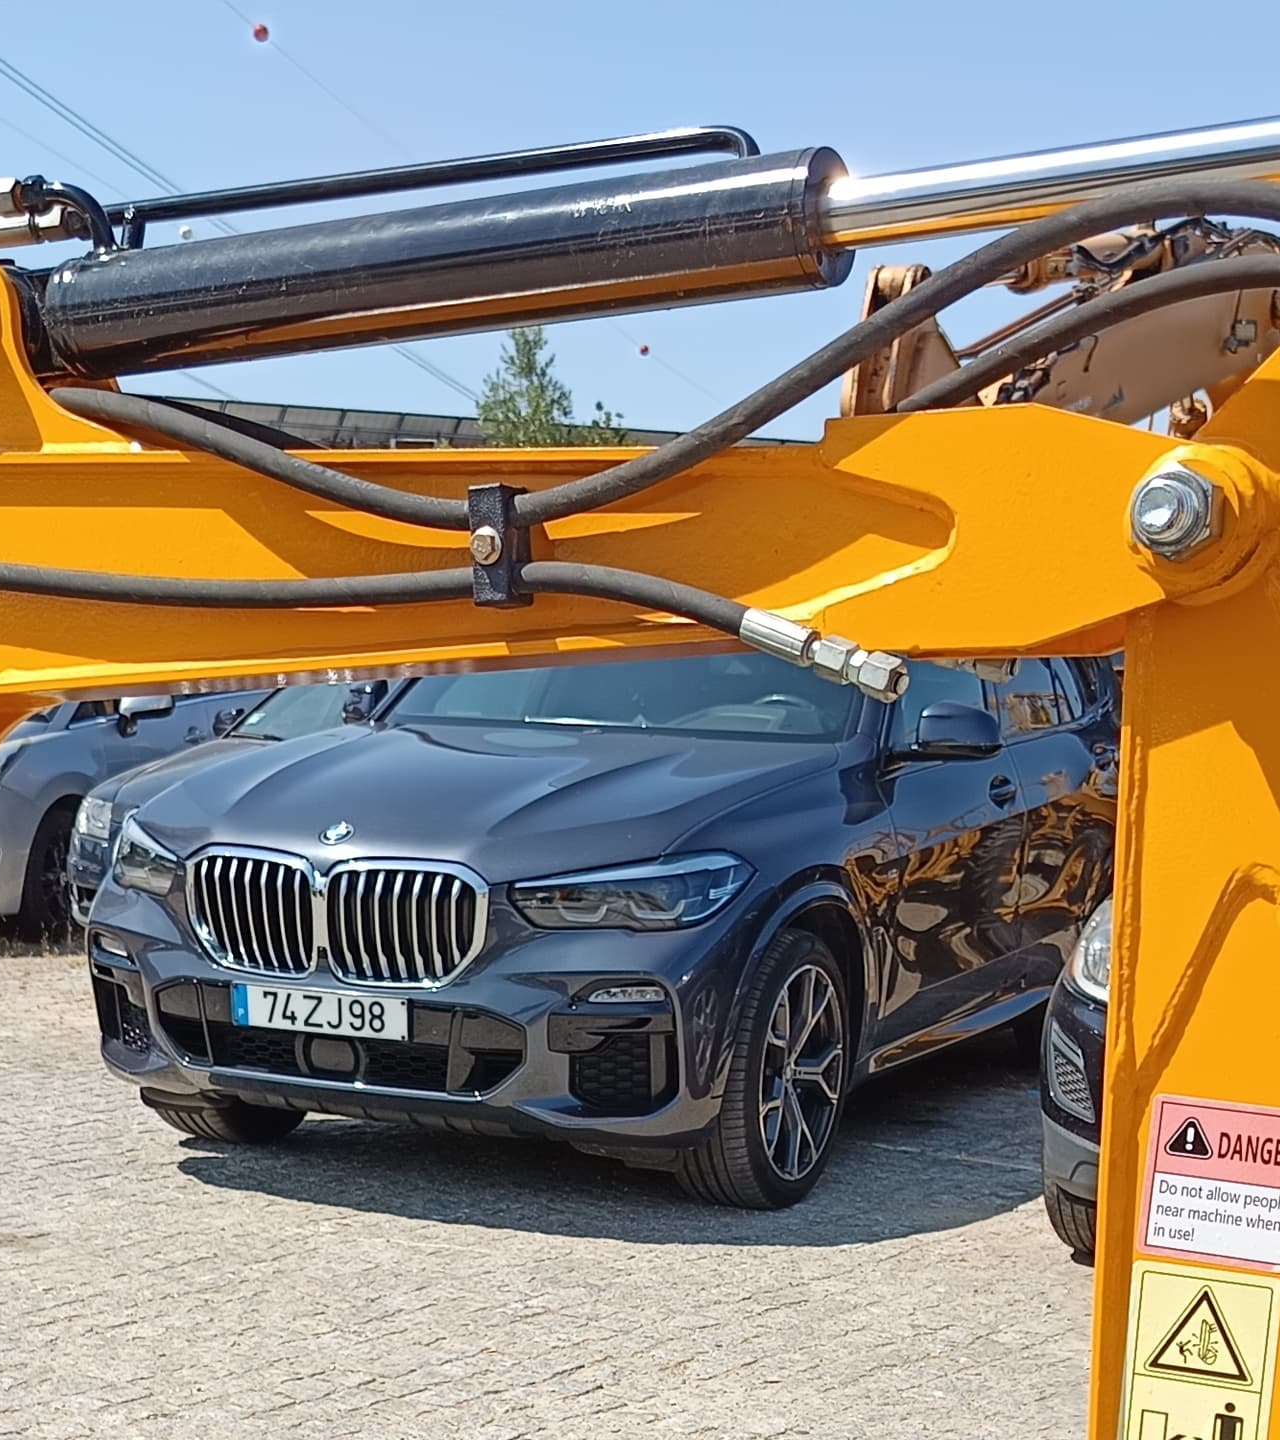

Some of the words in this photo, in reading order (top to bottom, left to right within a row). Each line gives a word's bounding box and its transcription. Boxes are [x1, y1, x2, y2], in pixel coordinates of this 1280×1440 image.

[262, 991, 385, 1033] 74ZJ98
[1159, 1179, 1178, 1195] Do
[1180, 1185, 1203, 1199] not
[1206, 1186, 1241, 1204] allow
[1156, 1203, 1185, 1219] near
[1187, 1208, 1243, 1227] machine
[1153, 1222, 1166, 1238] in
[1168, 1227, 1195, 1242] use!
